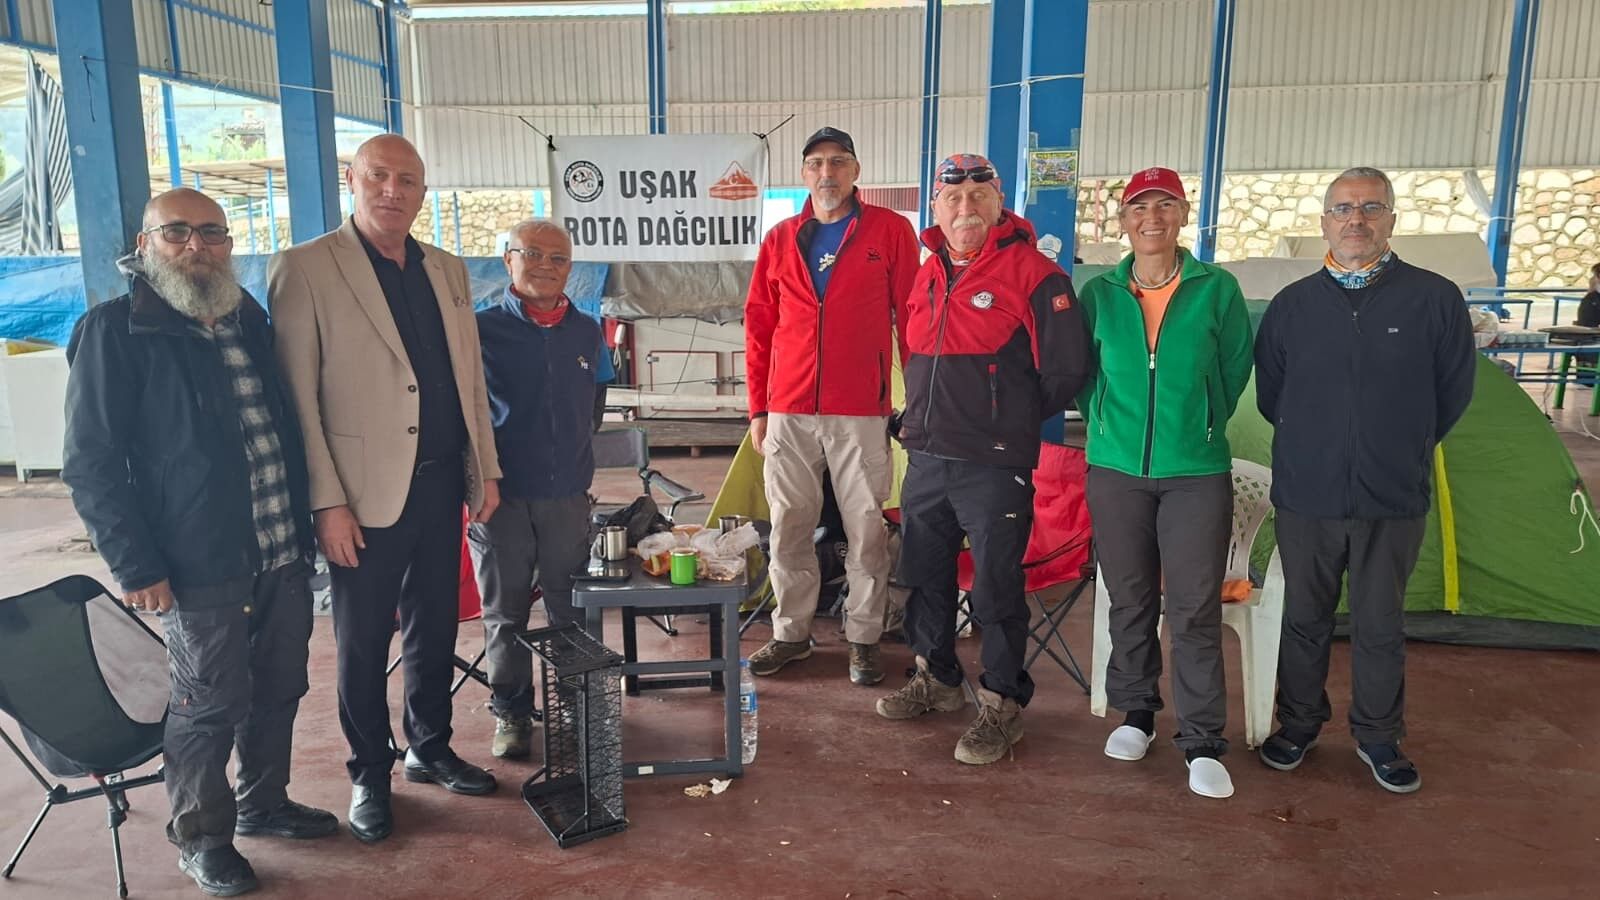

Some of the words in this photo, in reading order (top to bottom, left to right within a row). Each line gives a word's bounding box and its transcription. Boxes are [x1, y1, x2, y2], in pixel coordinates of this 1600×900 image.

[619, 170, 697, 204] UŞAK
[564, 217, 628, 246] ROTA
[637, 210, 757, 246] DAĞCILIK
